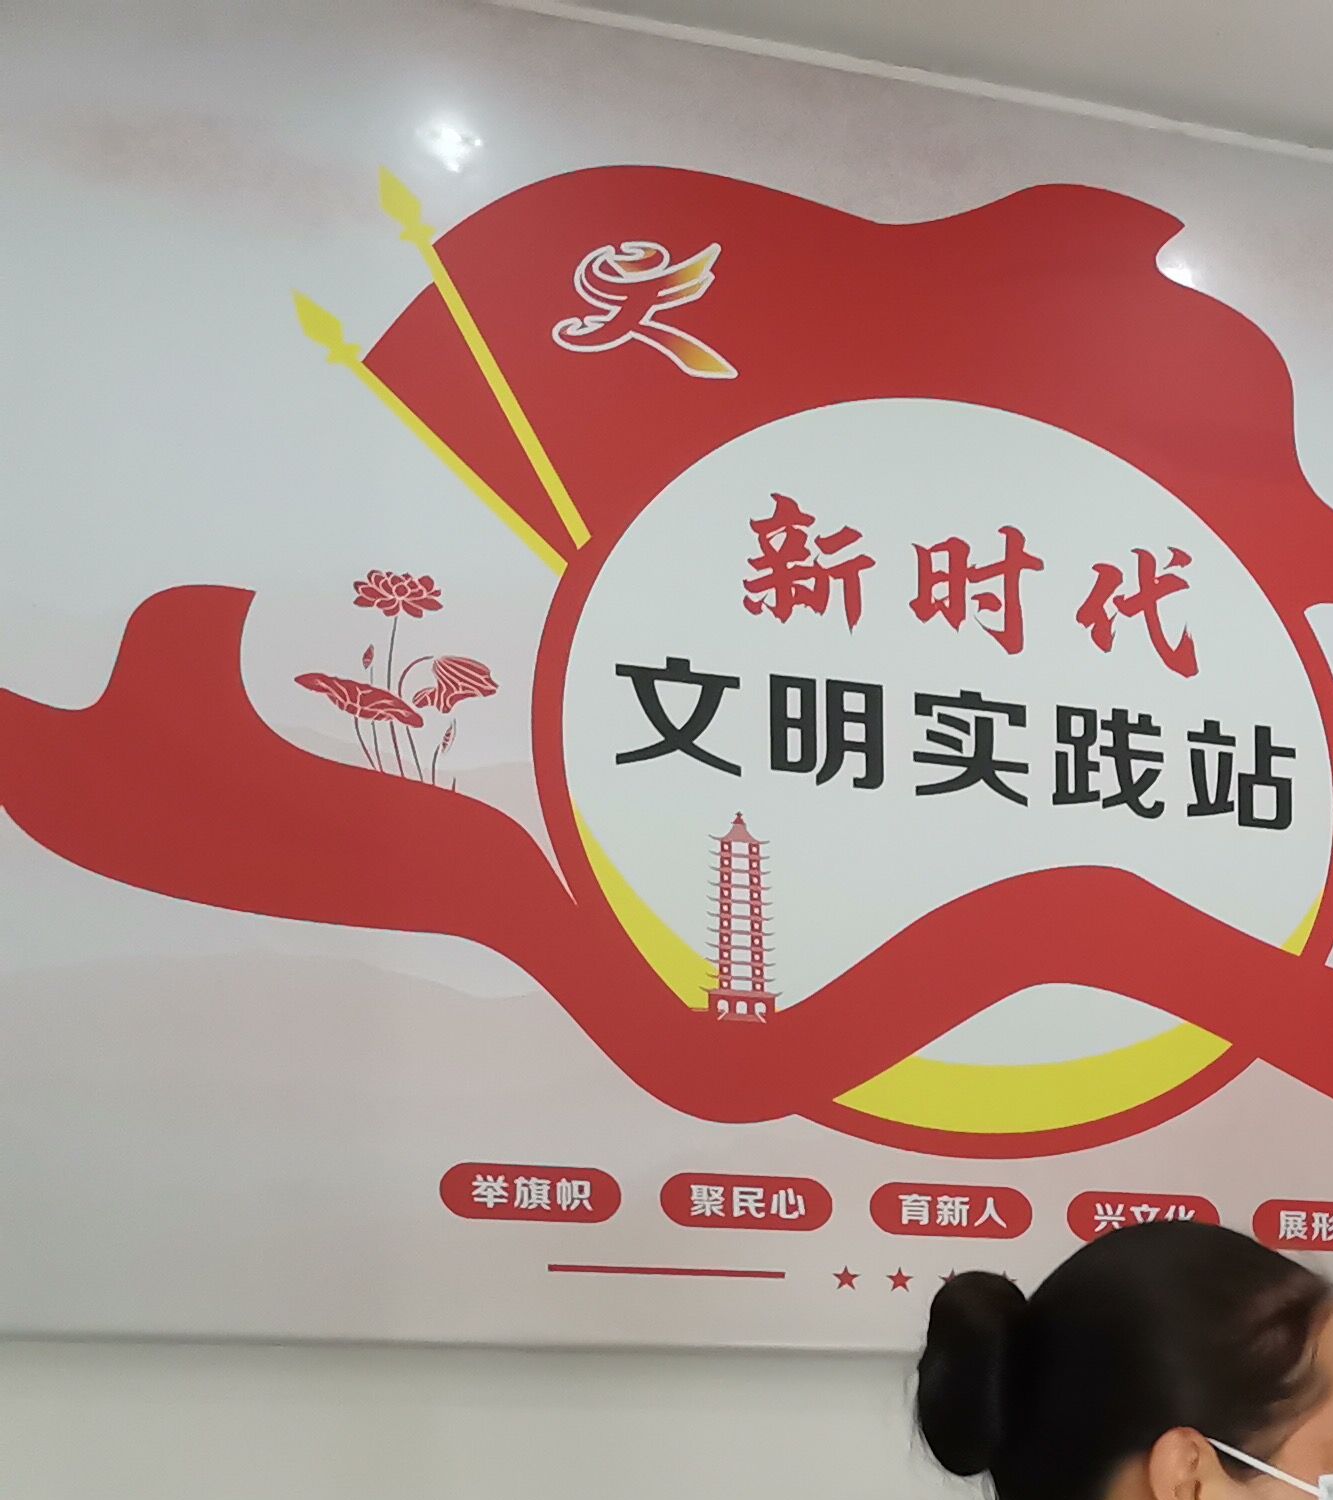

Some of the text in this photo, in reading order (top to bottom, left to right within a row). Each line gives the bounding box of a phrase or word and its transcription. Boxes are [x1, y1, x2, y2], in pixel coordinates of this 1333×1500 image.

[742, 492, 1200, 678] 新时代
[614, 655, 1297, 831] 文明实践站
[471, 1174, 594, 1212] 举旗帜
[690, 1184, 805, 1220] 聚民心
[899, 1191, 1007, 1228] 育新人
